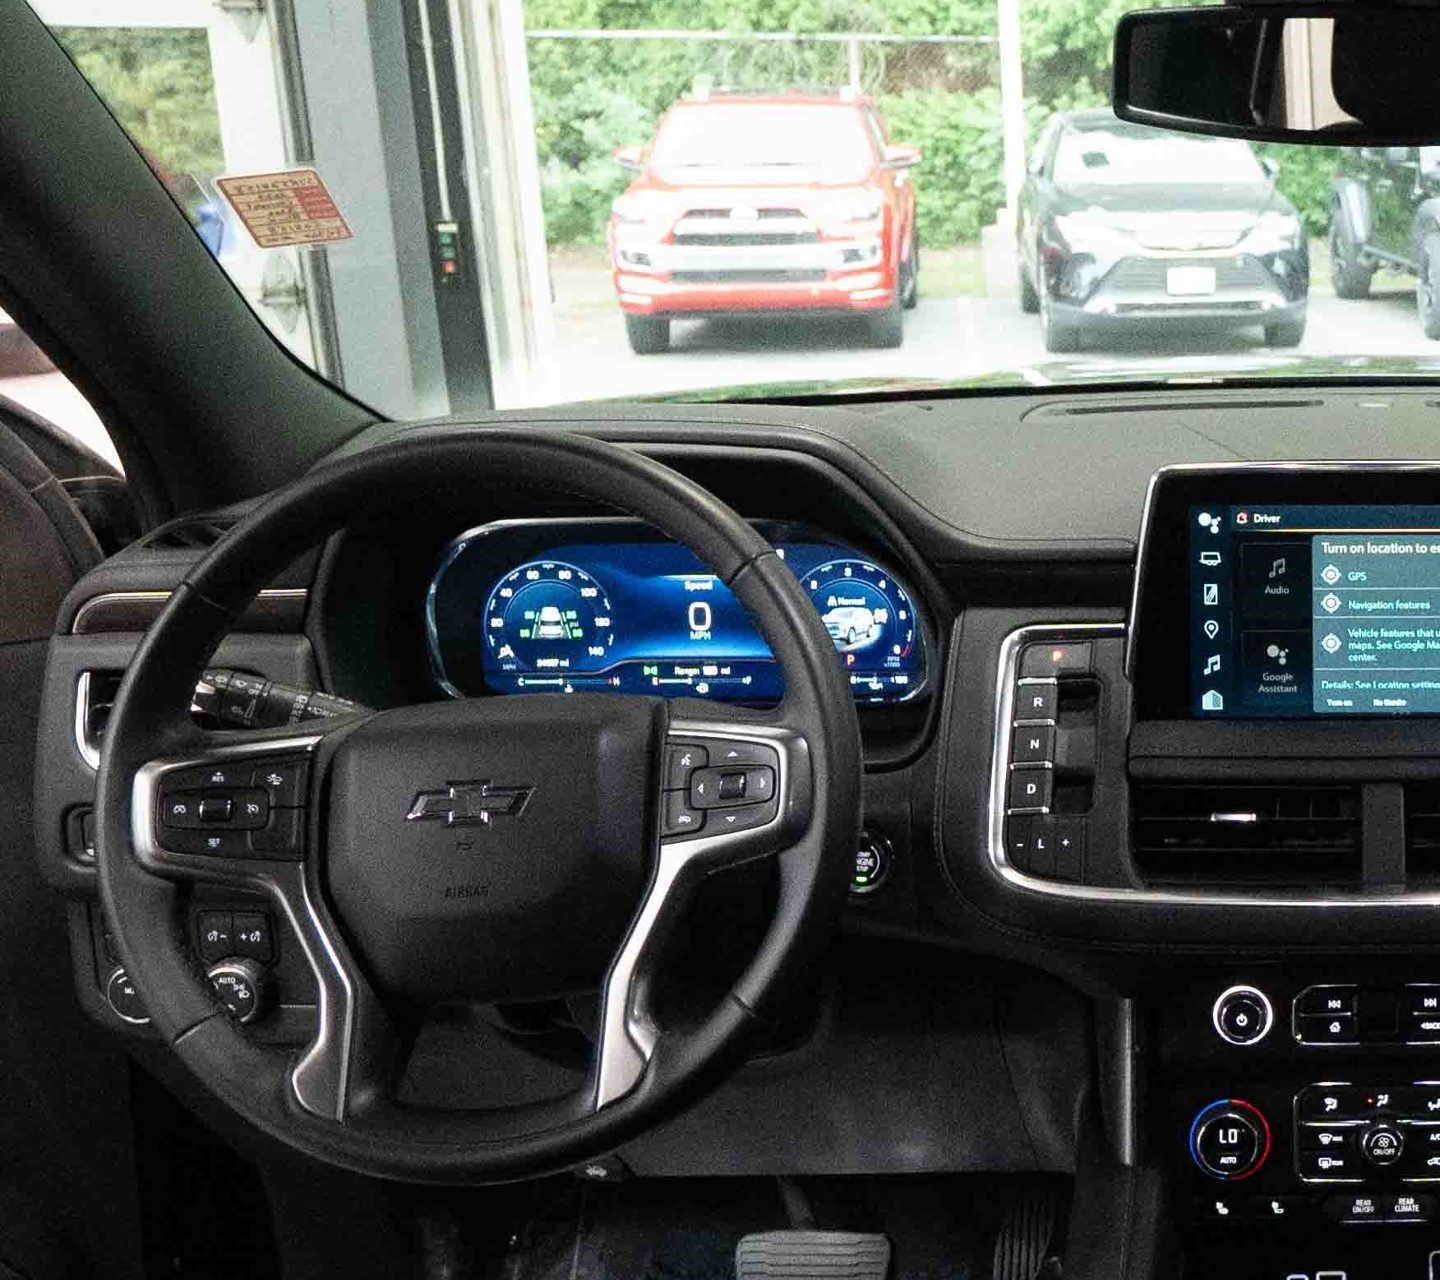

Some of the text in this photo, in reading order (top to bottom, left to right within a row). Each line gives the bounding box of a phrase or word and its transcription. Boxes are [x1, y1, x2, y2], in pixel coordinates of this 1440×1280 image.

[1253, 513, 1281, 524] Driver
[1321, 542, 1347, 554] Turn
[1350, 545, 1364, 554] on
[1367, 542, 1413, 554] location
[1415, 543, 1428, 554] to
[1348, 571, 1367, 581] GPS
[1264, 585, 1290, 595] Audio
[1348, 599, 1430, 611] Navigation features
[688, 601, 712, 631] 0
[690, 631, 711, 641] MPH
[1348, 628, 1378, 638] Vehicle
[1380, 628, 1415, 638] features
[1417, 628, 1434, 638] that
[1375, 640, 1392, 650] See
[1394, 640, 1425, 652] Google
[846, 655, 855, 666] P
[1262, 672, 1294, 683] Google
[1258, 684, 1298, 694] Assistant
[1033, 697, 1043, 707] R
[1030, 739, 1040, 749] N
[1026, 784, 1036, 795] D
[1037, 838, 1044, 849] L
[1219, 1129, 1238, 1144] LO
[1394, 1204, 1420, 1212] CLIMATE
